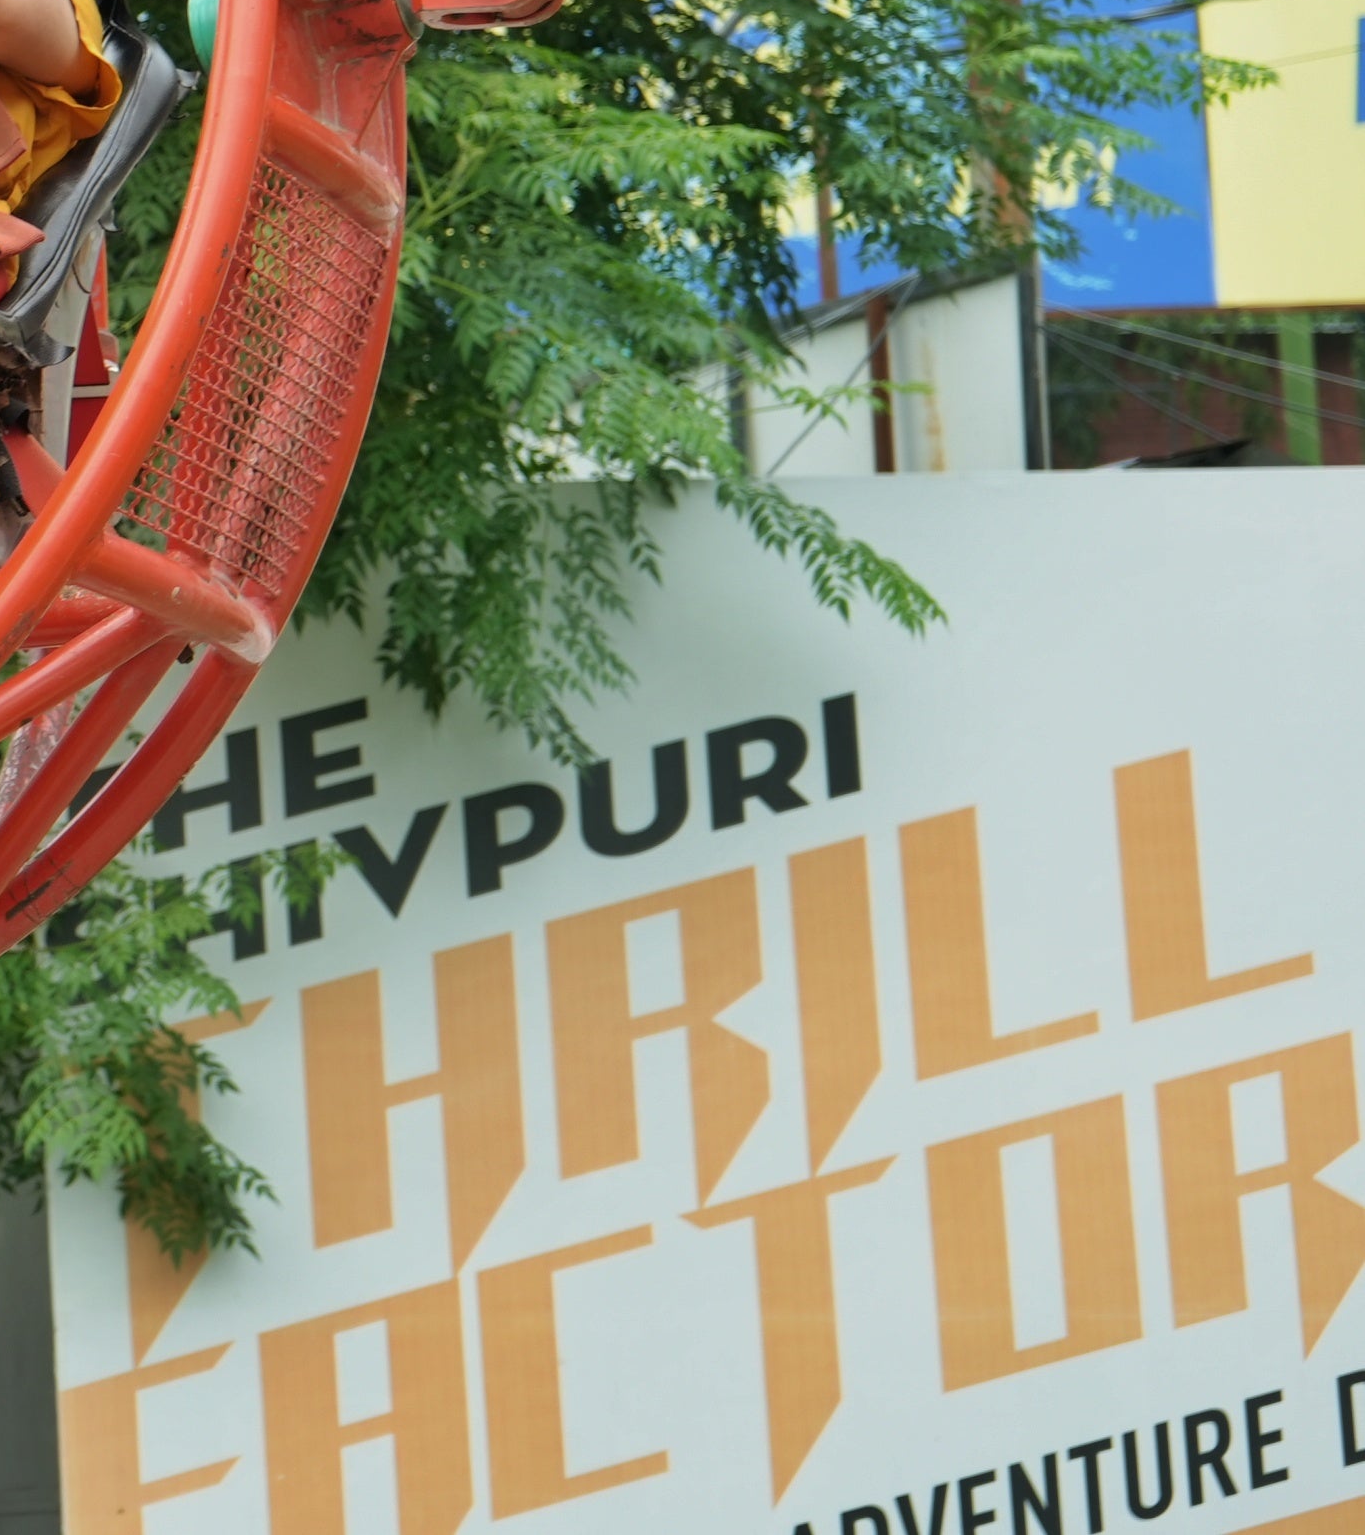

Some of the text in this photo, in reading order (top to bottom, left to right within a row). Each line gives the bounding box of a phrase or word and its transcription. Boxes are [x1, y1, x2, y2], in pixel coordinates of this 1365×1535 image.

[45, 692, 864, 1010] HIVPURI
[68, 696, 377, 857] HE
[60, 747, 1314, 1371] THRILL
[790, 1388, 1290, 1535] VENTURE
